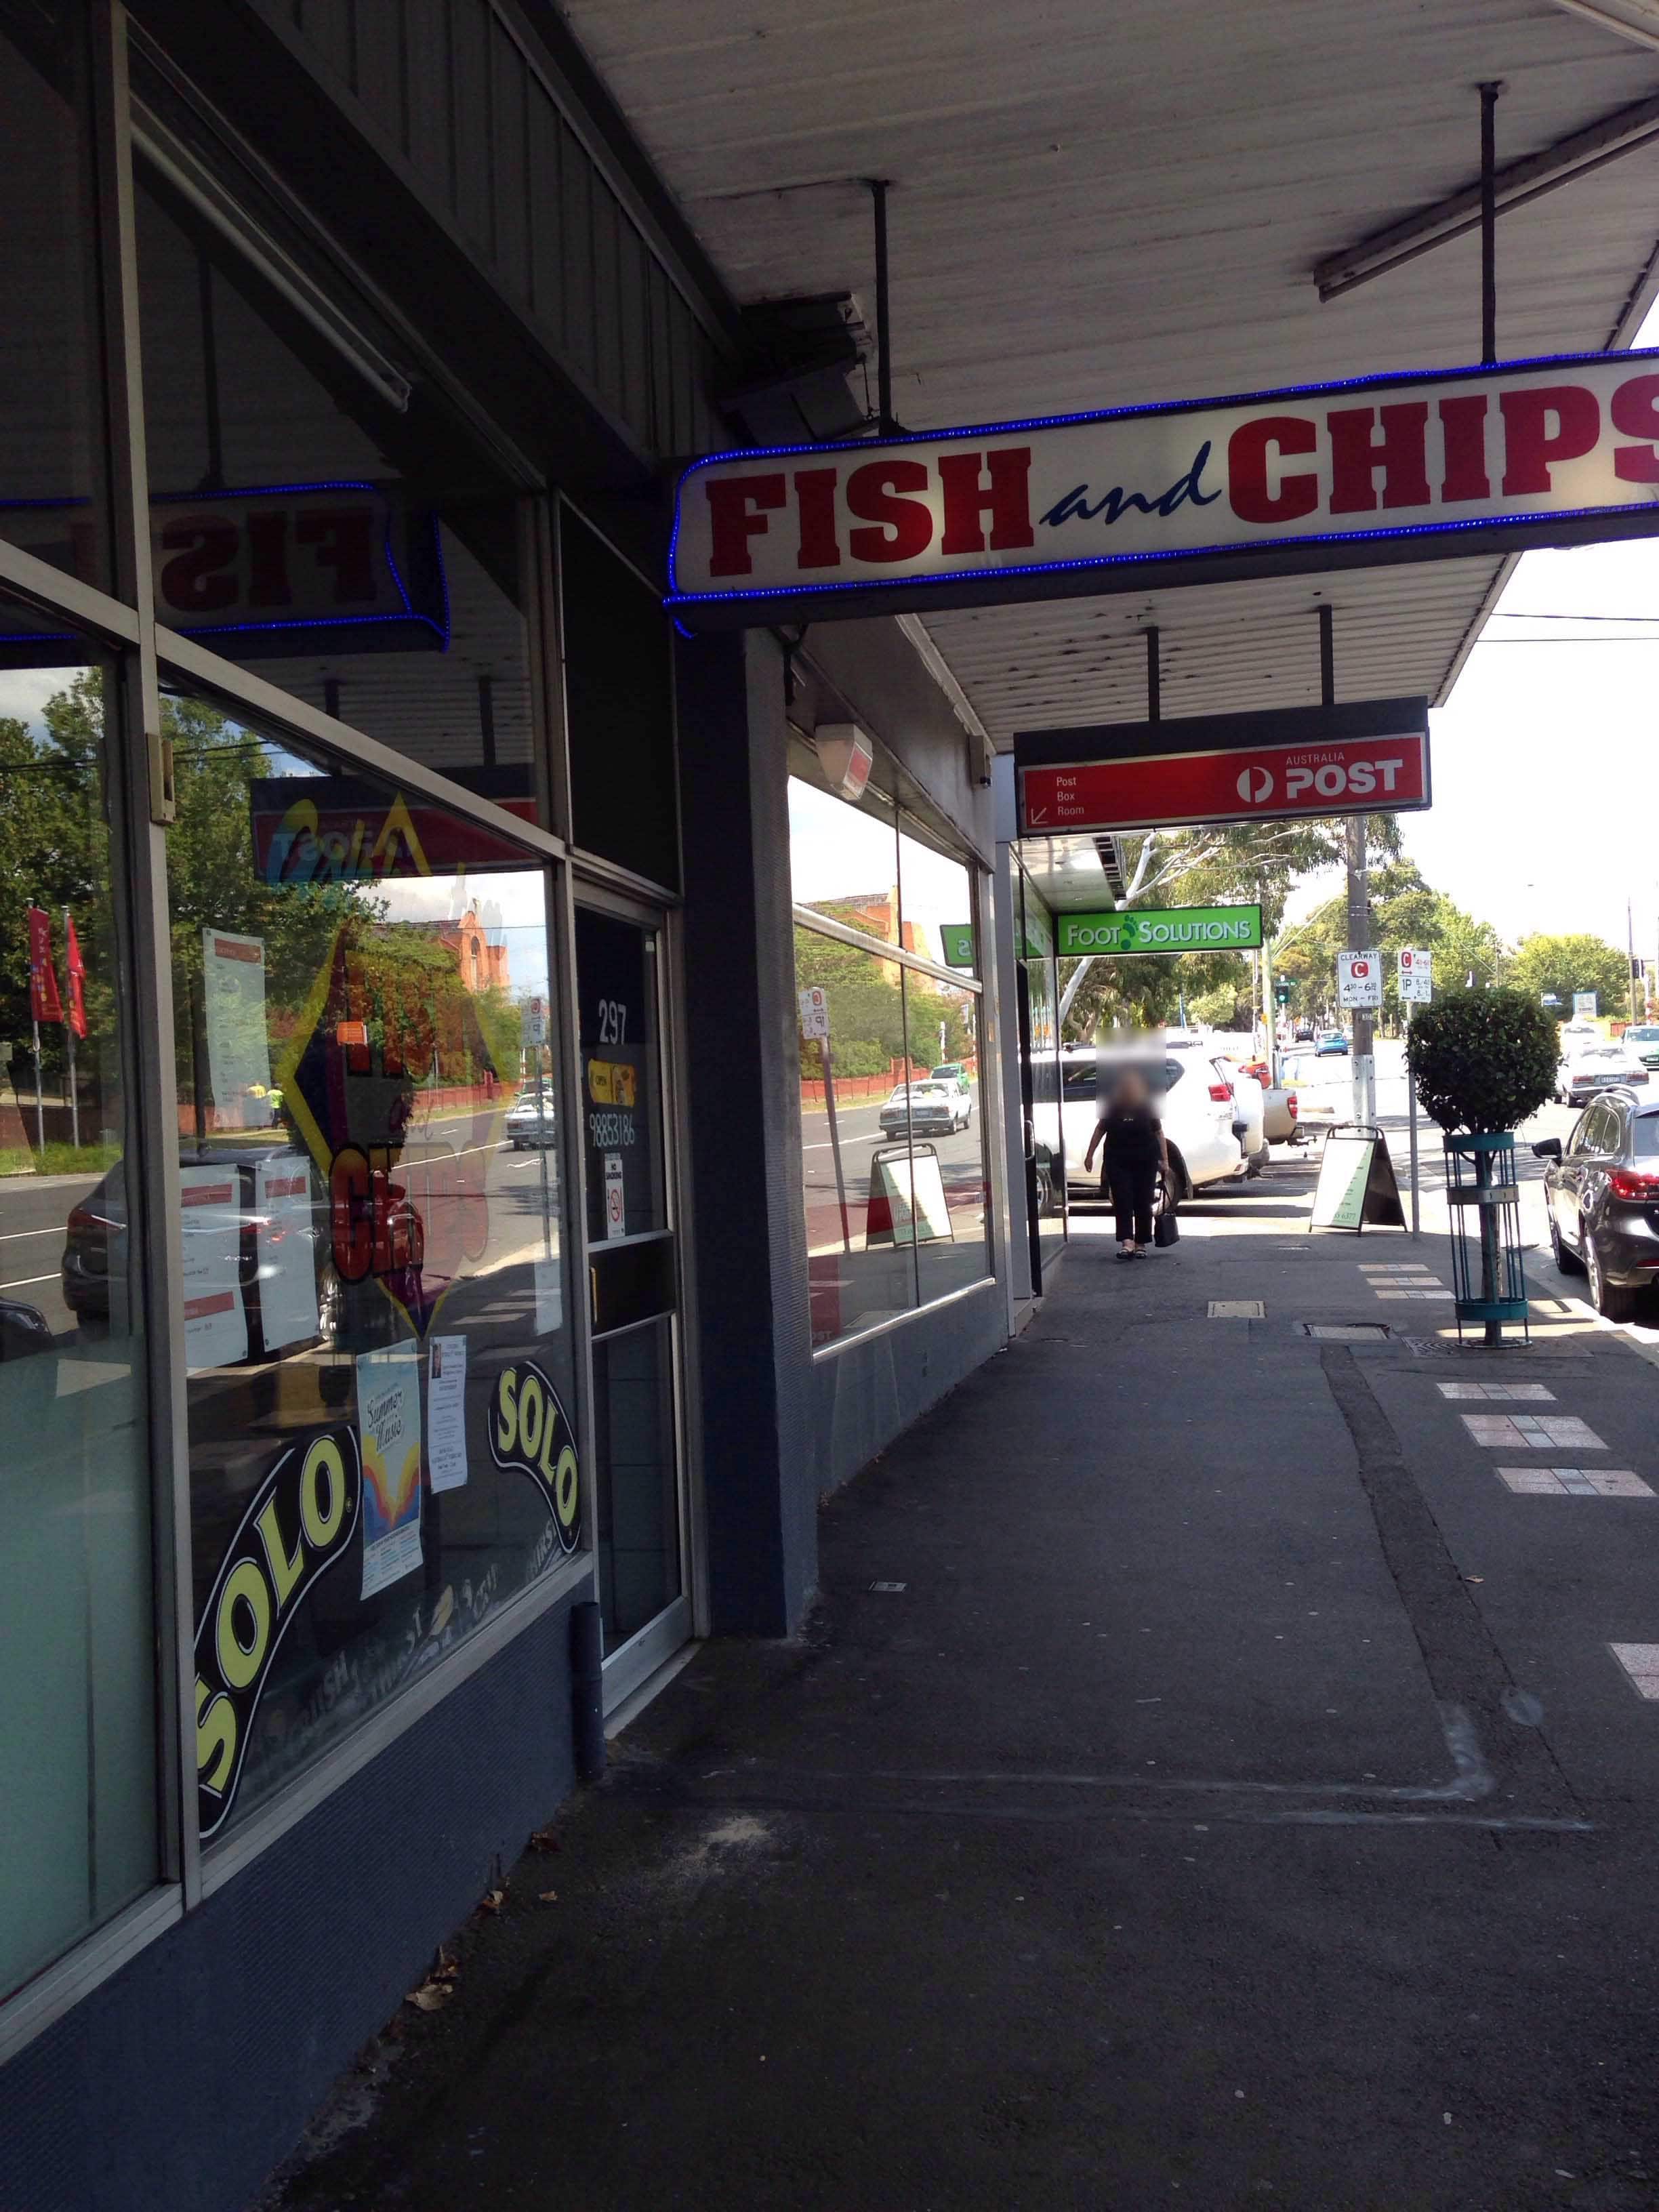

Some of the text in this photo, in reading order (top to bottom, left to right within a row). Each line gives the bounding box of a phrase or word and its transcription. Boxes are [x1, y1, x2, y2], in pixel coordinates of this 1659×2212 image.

[705, 447, 1034, 577] FISH
[1039, 440, 1222, 527] and
[1286, 752, 1345, 766] AUSTRALIA
[1286, 758, 1403, 800] POST
[1056, 775, 1078, 787] Post
[1057, 790, 1076, 802] Box
[1057, 804, 1085, 816] Room
[1067, 920, 1252, 947] FOOT SOLUTIONS
[597, 998, 628, 1046] 297
[590, 1113, 635, 1149] 98853186
[367, 1388, 405, 1428] Summer
[375, 1414, 403, 1454] Music
[497, 1365, 579, 1529] SOLO
[194, 1433, 346, 1797] SOLO
